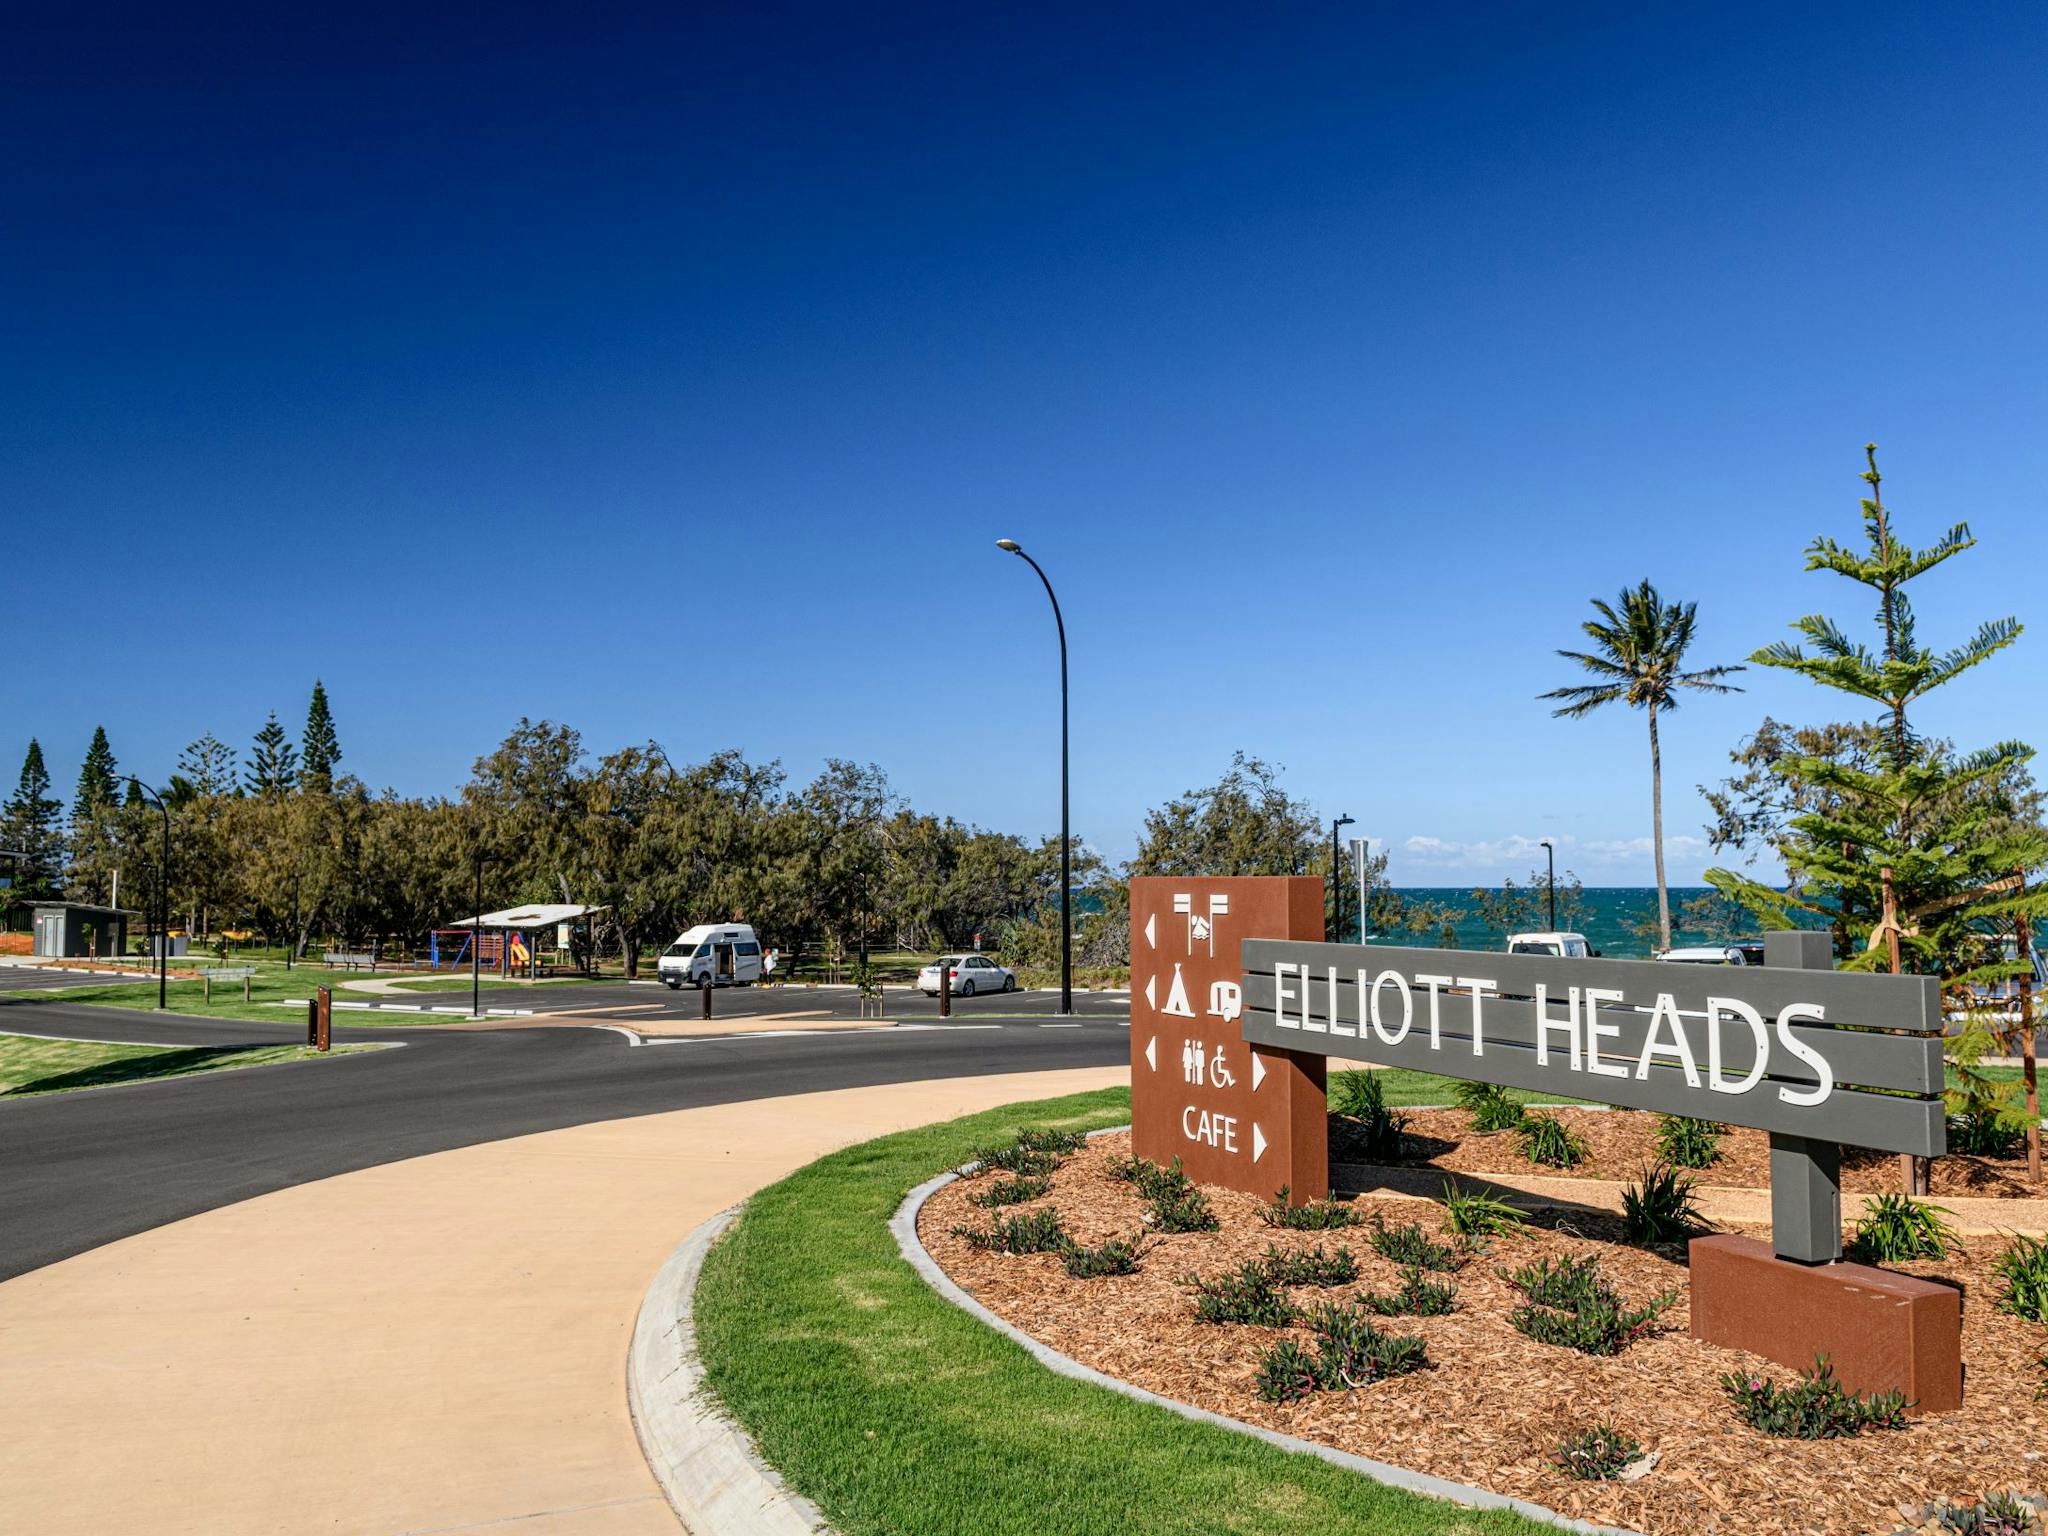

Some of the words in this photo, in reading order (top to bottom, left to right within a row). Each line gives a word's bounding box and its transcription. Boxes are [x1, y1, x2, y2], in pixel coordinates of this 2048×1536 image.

[1274, 962, 1498, 1057] ELLIOTT
[1535, 983, 1834, 1107] HEADS
[1182, 1105, 1239, 1154] CAFE
